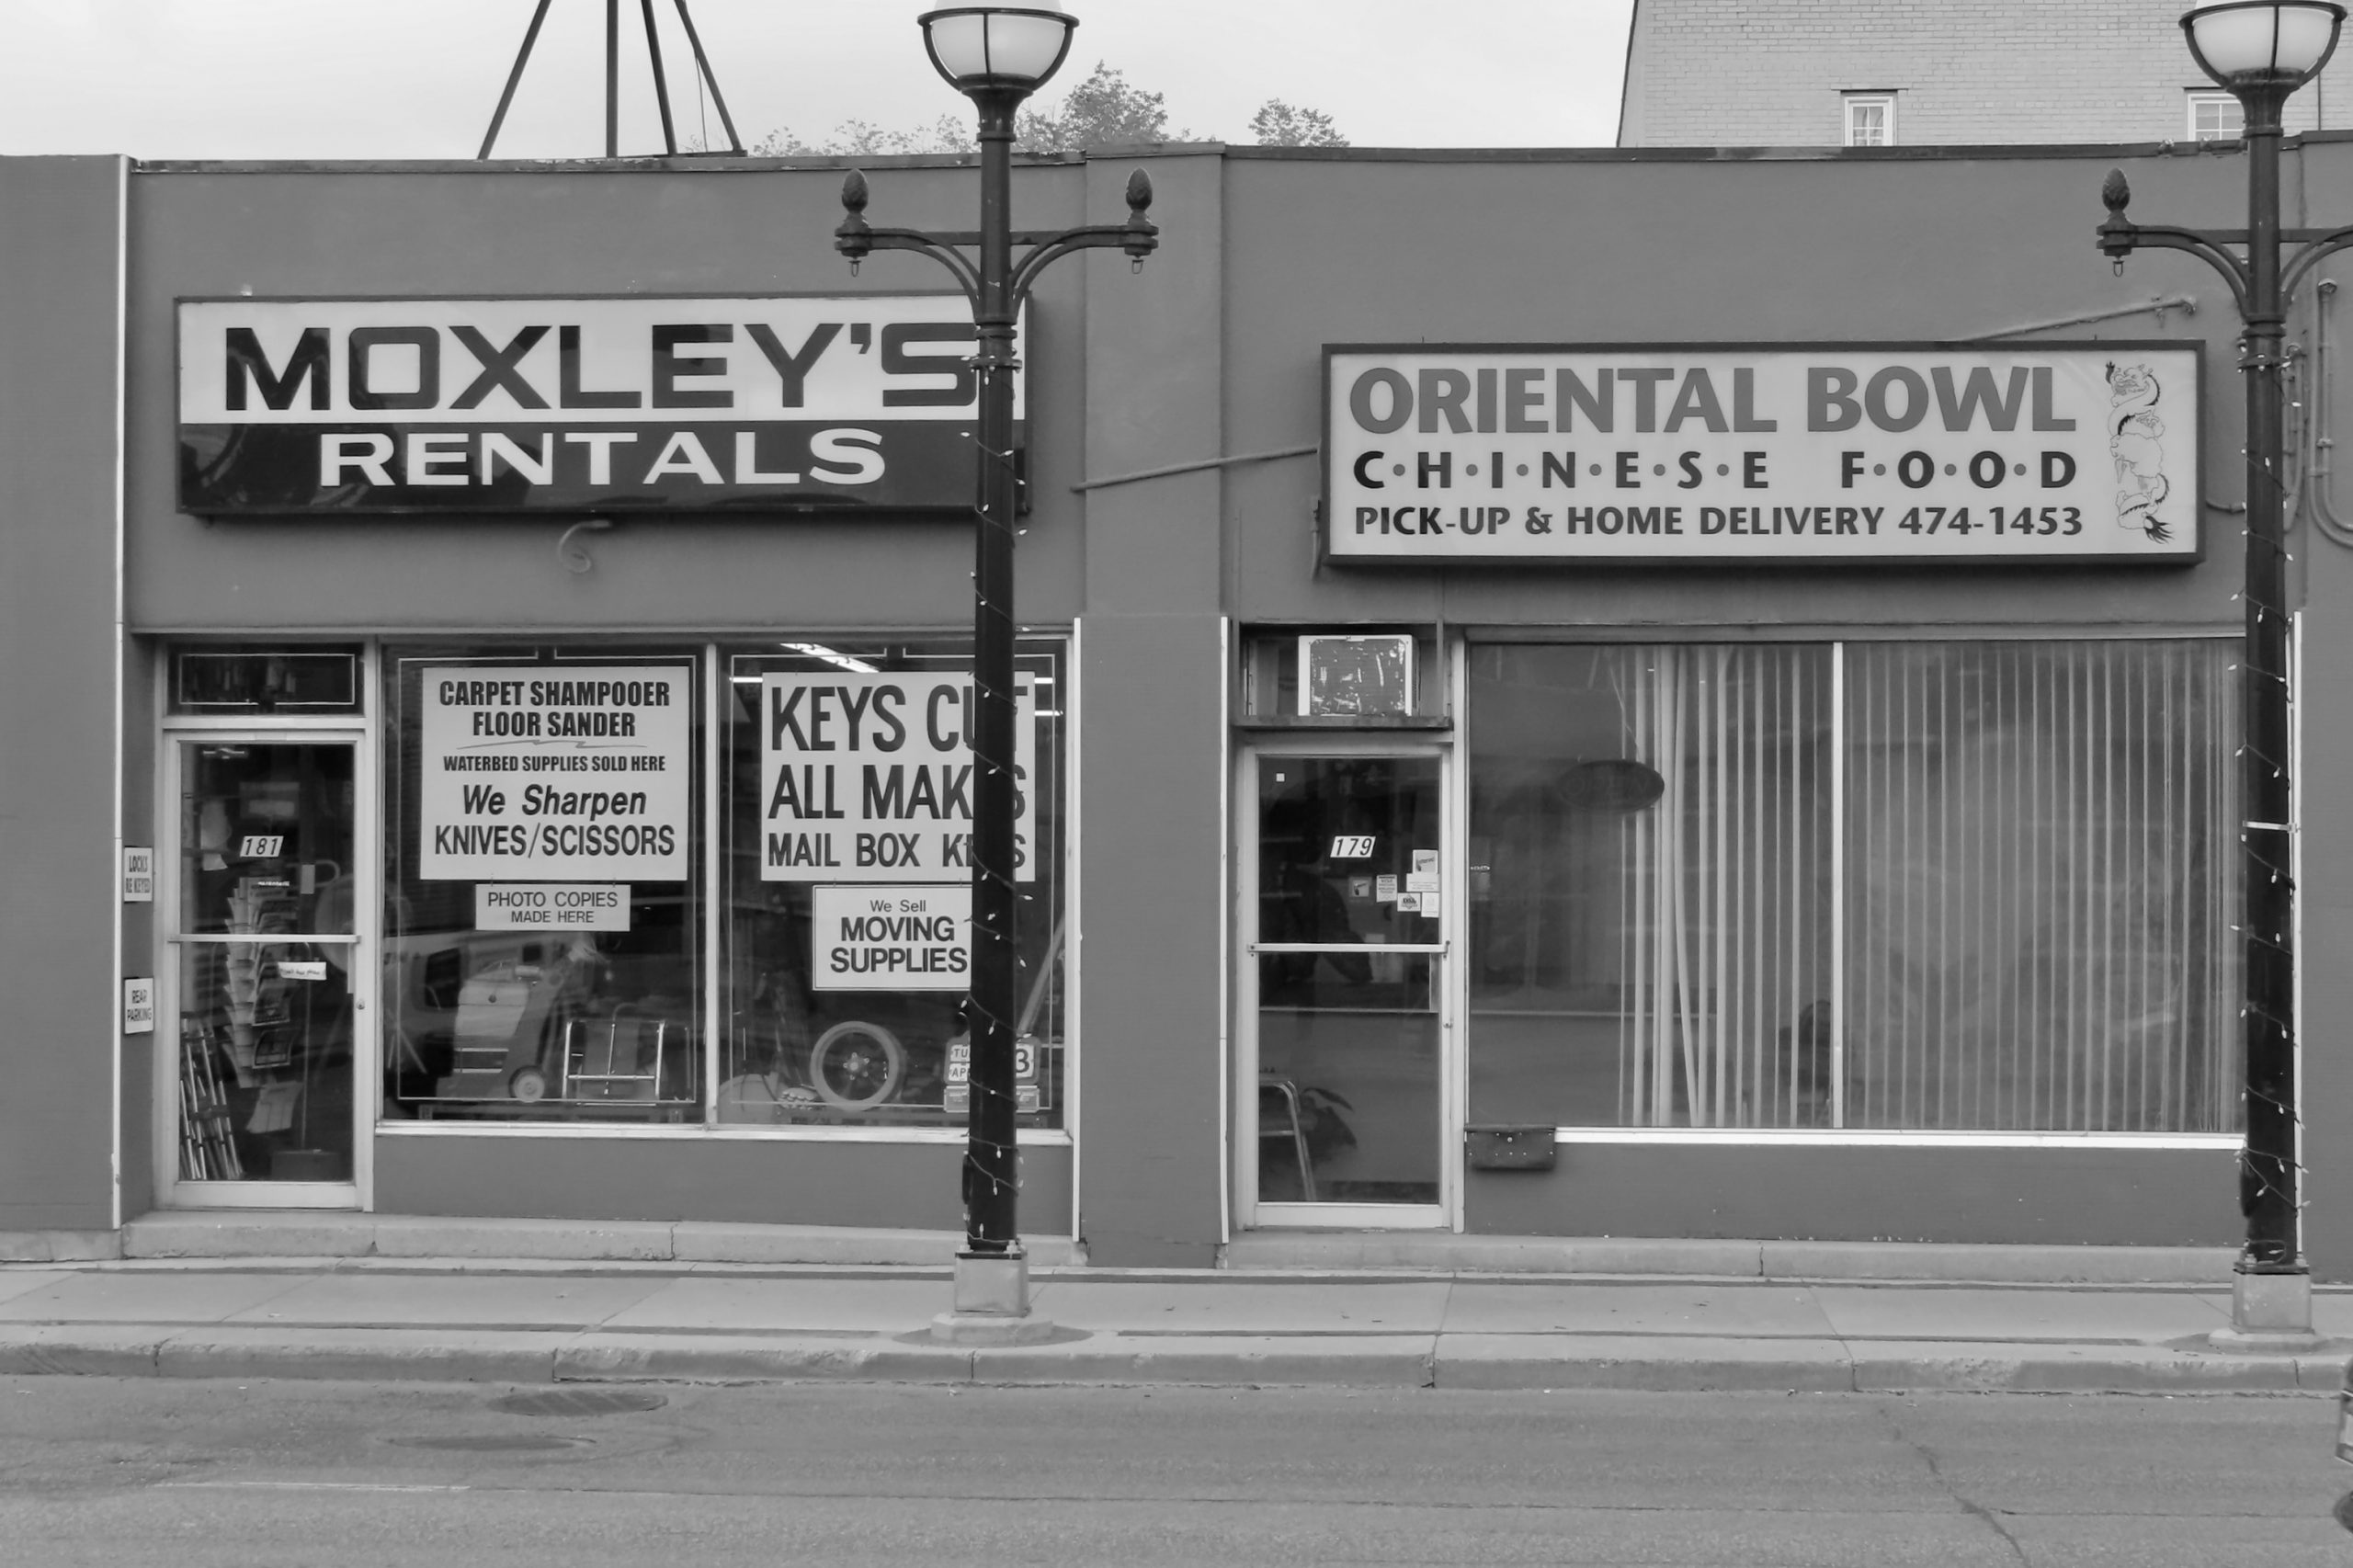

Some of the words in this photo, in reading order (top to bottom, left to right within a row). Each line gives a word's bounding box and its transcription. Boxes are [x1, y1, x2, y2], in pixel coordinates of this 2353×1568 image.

[225, 323, 977, 411] MOXLEY'S
[1349, 368, 1777, 434] ORIENTAL
[1808, 366, 2075, 433] BOWL
[321, 428, 884, 485] RENTALS
[1356, 507, 1510, 536] PICK-UP
[1526, 507, 1552, 535] &
[1567, 506, 1683, 535] HOME
[1700, 506, 1884, 535] DELIVERY
[1898, 506, 2082, 536] 474-1453
[439, 681, 524, 706] CARPET
[530, 681, 670, 706] SHAMPOOER
[473, 711, 540, 736] FLOOR
[548, 712, 635, 736] SANDER
[772, 685, 905, 752] KEYS
[443, 756, 518, 771] WATERBED
[523, 756, 588, 771] SUPPLIES
[592, 756, 628, 771] SOLD
[631, 756, 665, 771] HERE
[463, 784, 506, 815] We
[522, 784, 647, 821] Sharpen
[768, 765, 844, 819] ALL
[863, 764, 1026, 820] MAK
[244, 837, 279, 856] 181
[435, 823, 675, 858] KNIVES/SCISSORS
[768, 833, 840, 867] MAIL
[856, 833, 921, 867] BOX
[1335, 837, 1372, 857] 179
[488, 892, 547, 907] PHOTO
[555, 892, 619, 907] COPIES
[870, 900, 892, 913] We
[900, 899, 926, 913] Sell
[511, 911, 551, 923] MADE
[558, 911, 595, 923] HERE
[841, 916, 955, 942] MOVING
[831, 948, 968, 972] SUPPLIES
